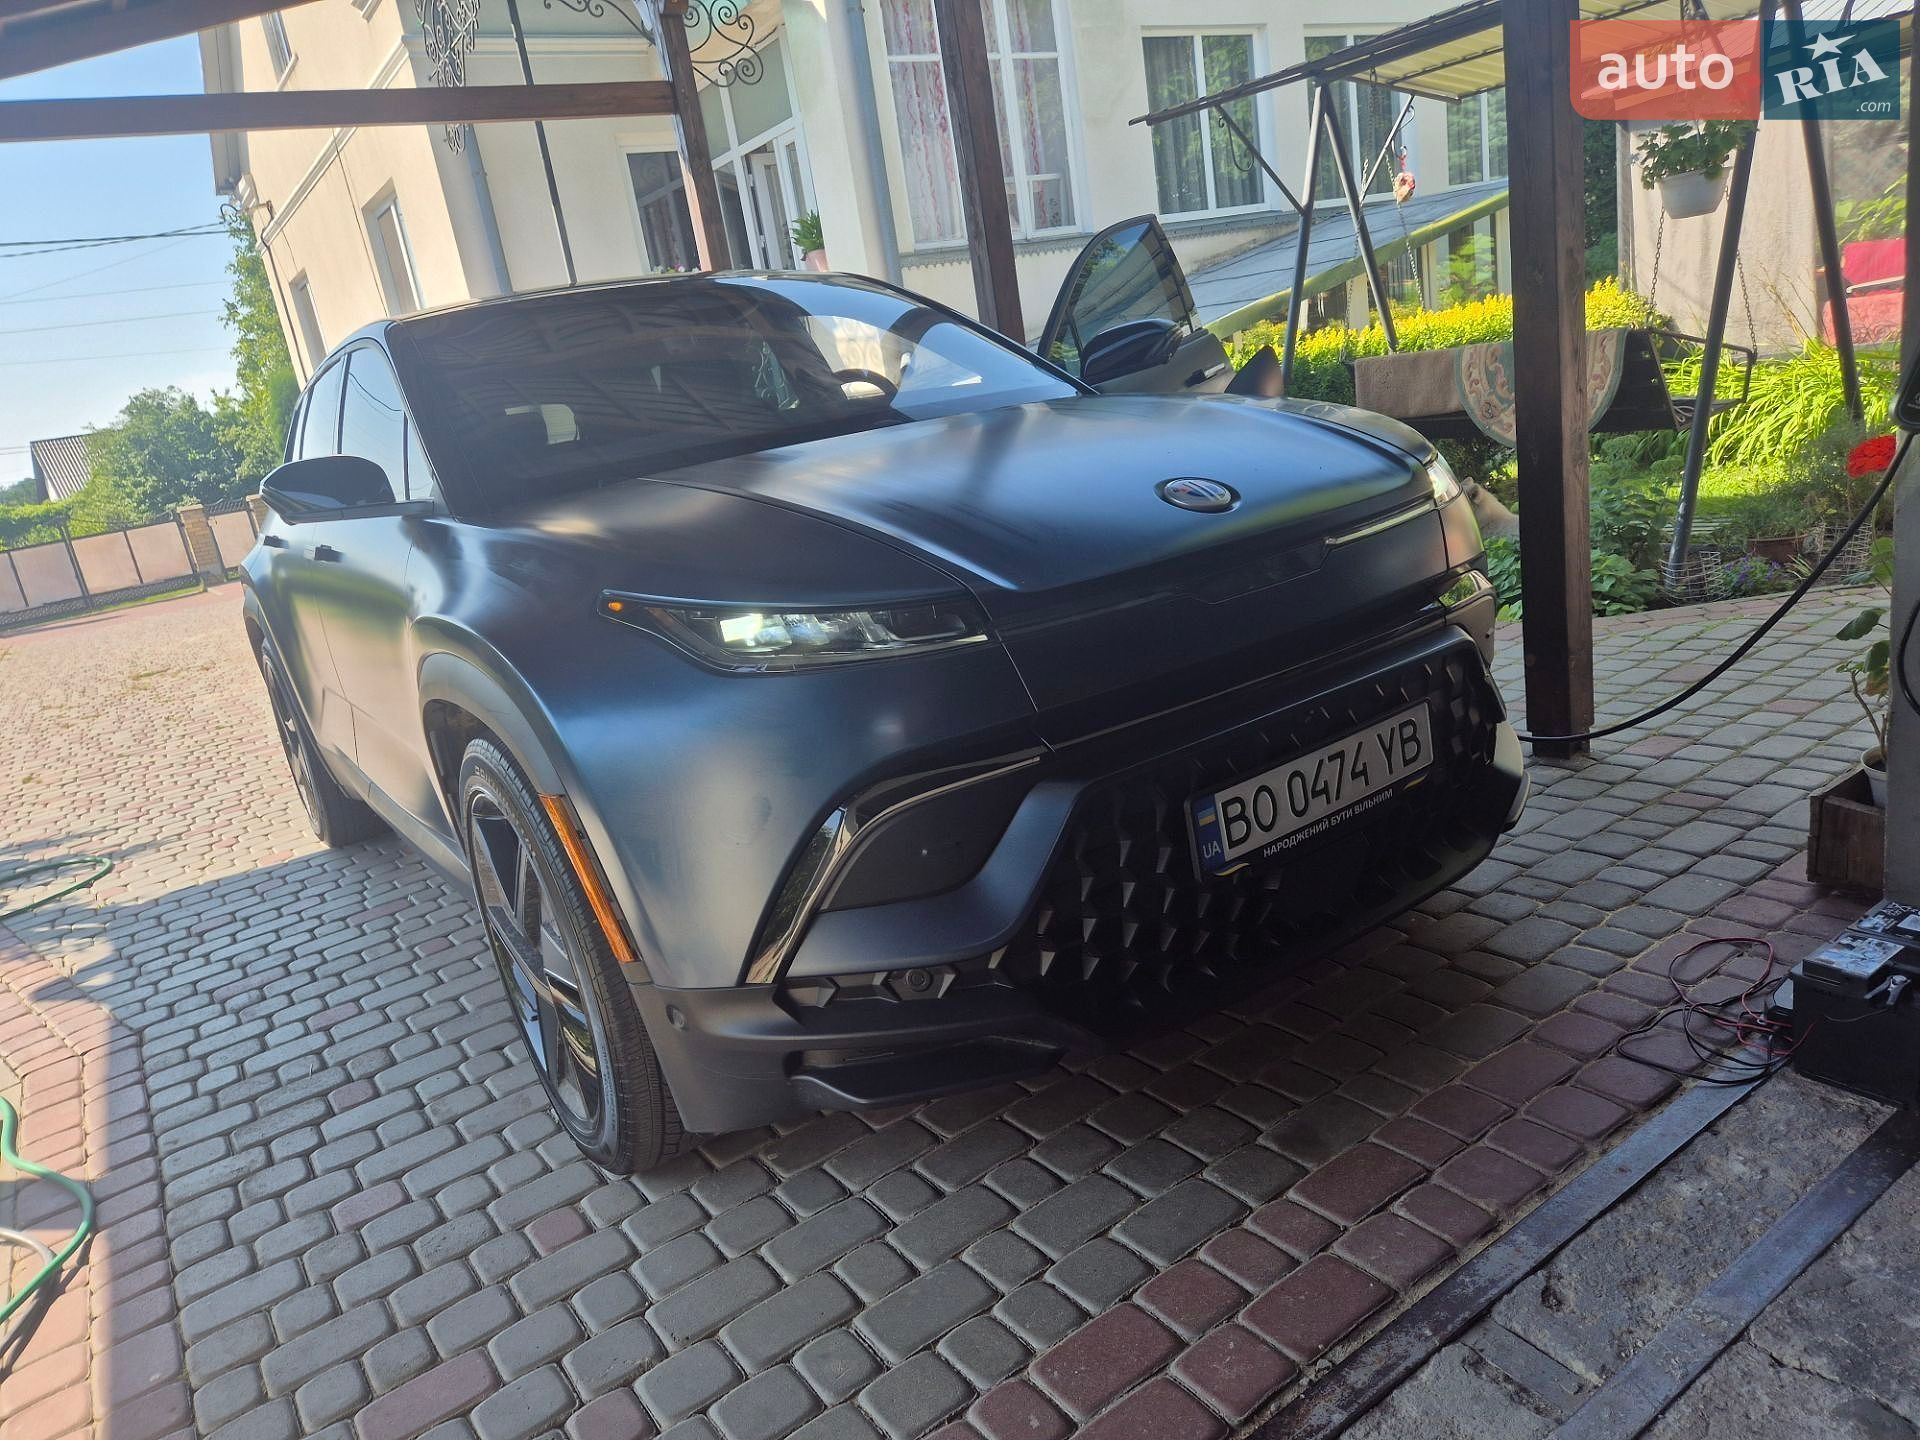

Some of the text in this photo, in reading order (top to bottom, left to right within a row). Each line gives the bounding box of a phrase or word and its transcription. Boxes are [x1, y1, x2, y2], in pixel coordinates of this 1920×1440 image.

[1220, 718, 1422, 850] BO 0474 YB
[1203, 840, 1222, 859] UA
[1263, 788, 1393, 858] НАРОДЖЕНИЙ БУТИ ВІЛЬНИМ
